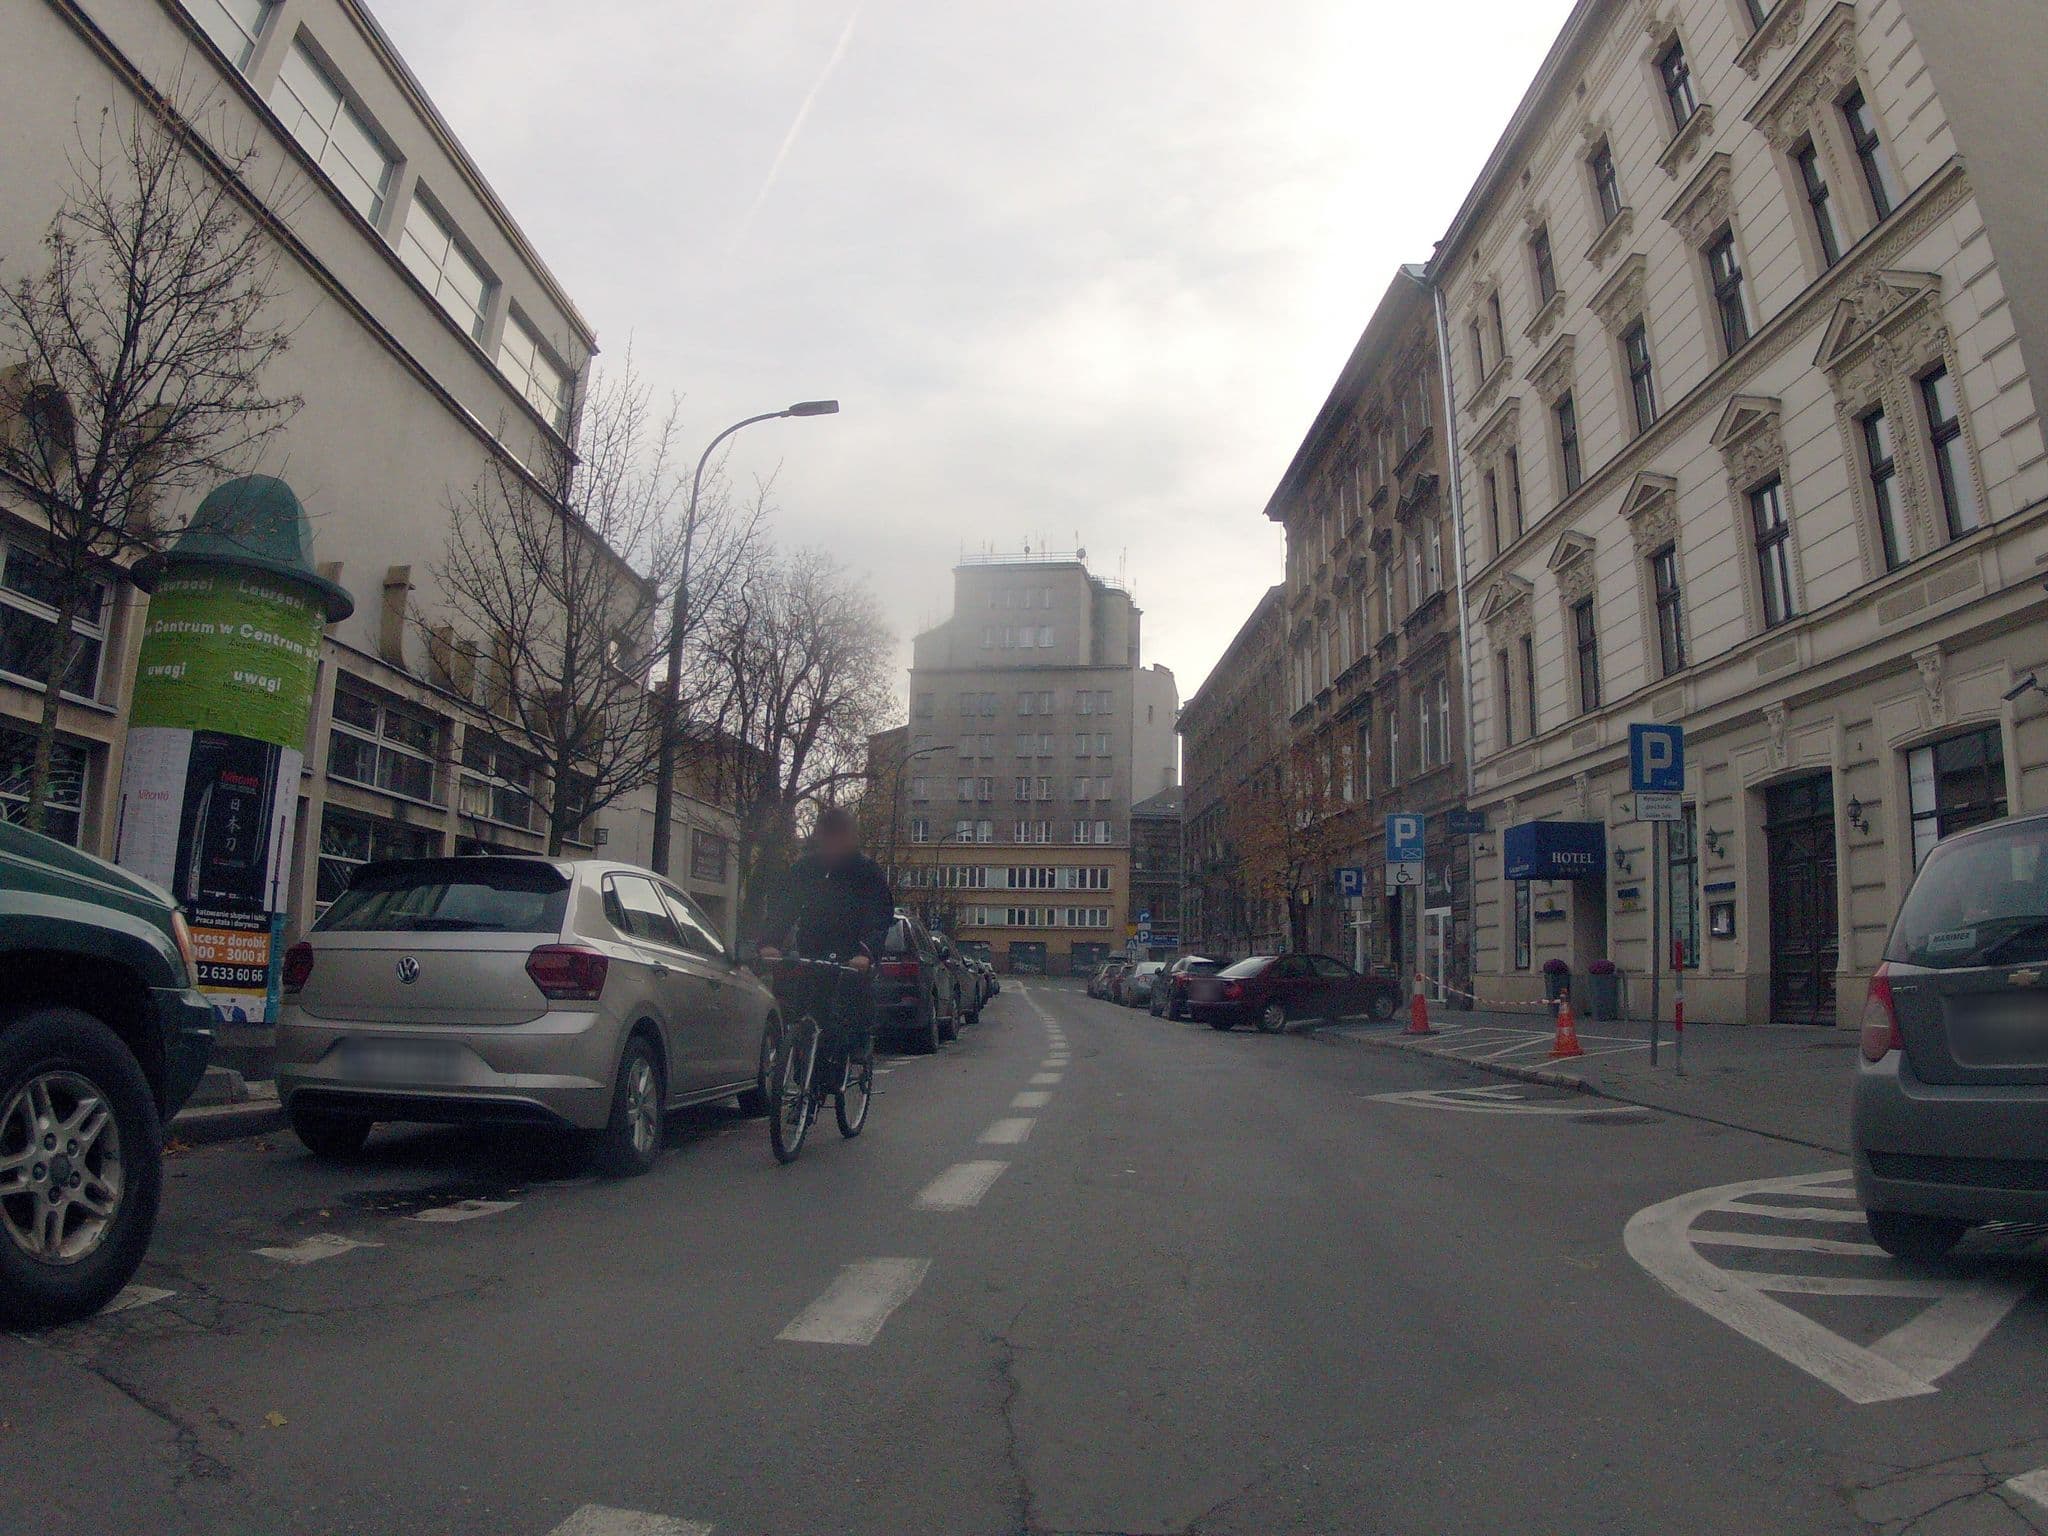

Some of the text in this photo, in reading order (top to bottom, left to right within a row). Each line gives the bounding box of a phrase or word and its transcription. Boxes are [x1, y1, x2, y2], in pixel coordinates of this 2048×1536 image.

[155, 619, 215, 635] Centrum
[220, 622, 234, 635] w
[239, 623, 303, 655] Centrum
[147, 662, 187, 679] uwagi
[233, 670, 282, 693] uwagi
[1642, 732, 1673, 784] P
[1394, 818, 1417, 848] P
[1551, 851, 1595, 864] HOTEL
[194, 945, 215, 959] 00
[227, 947, 255, 962] 3000
[211, 966, 235, 981] 633
[236, 968, 250, 982] 60
[251, 969, 264, 982] 66
